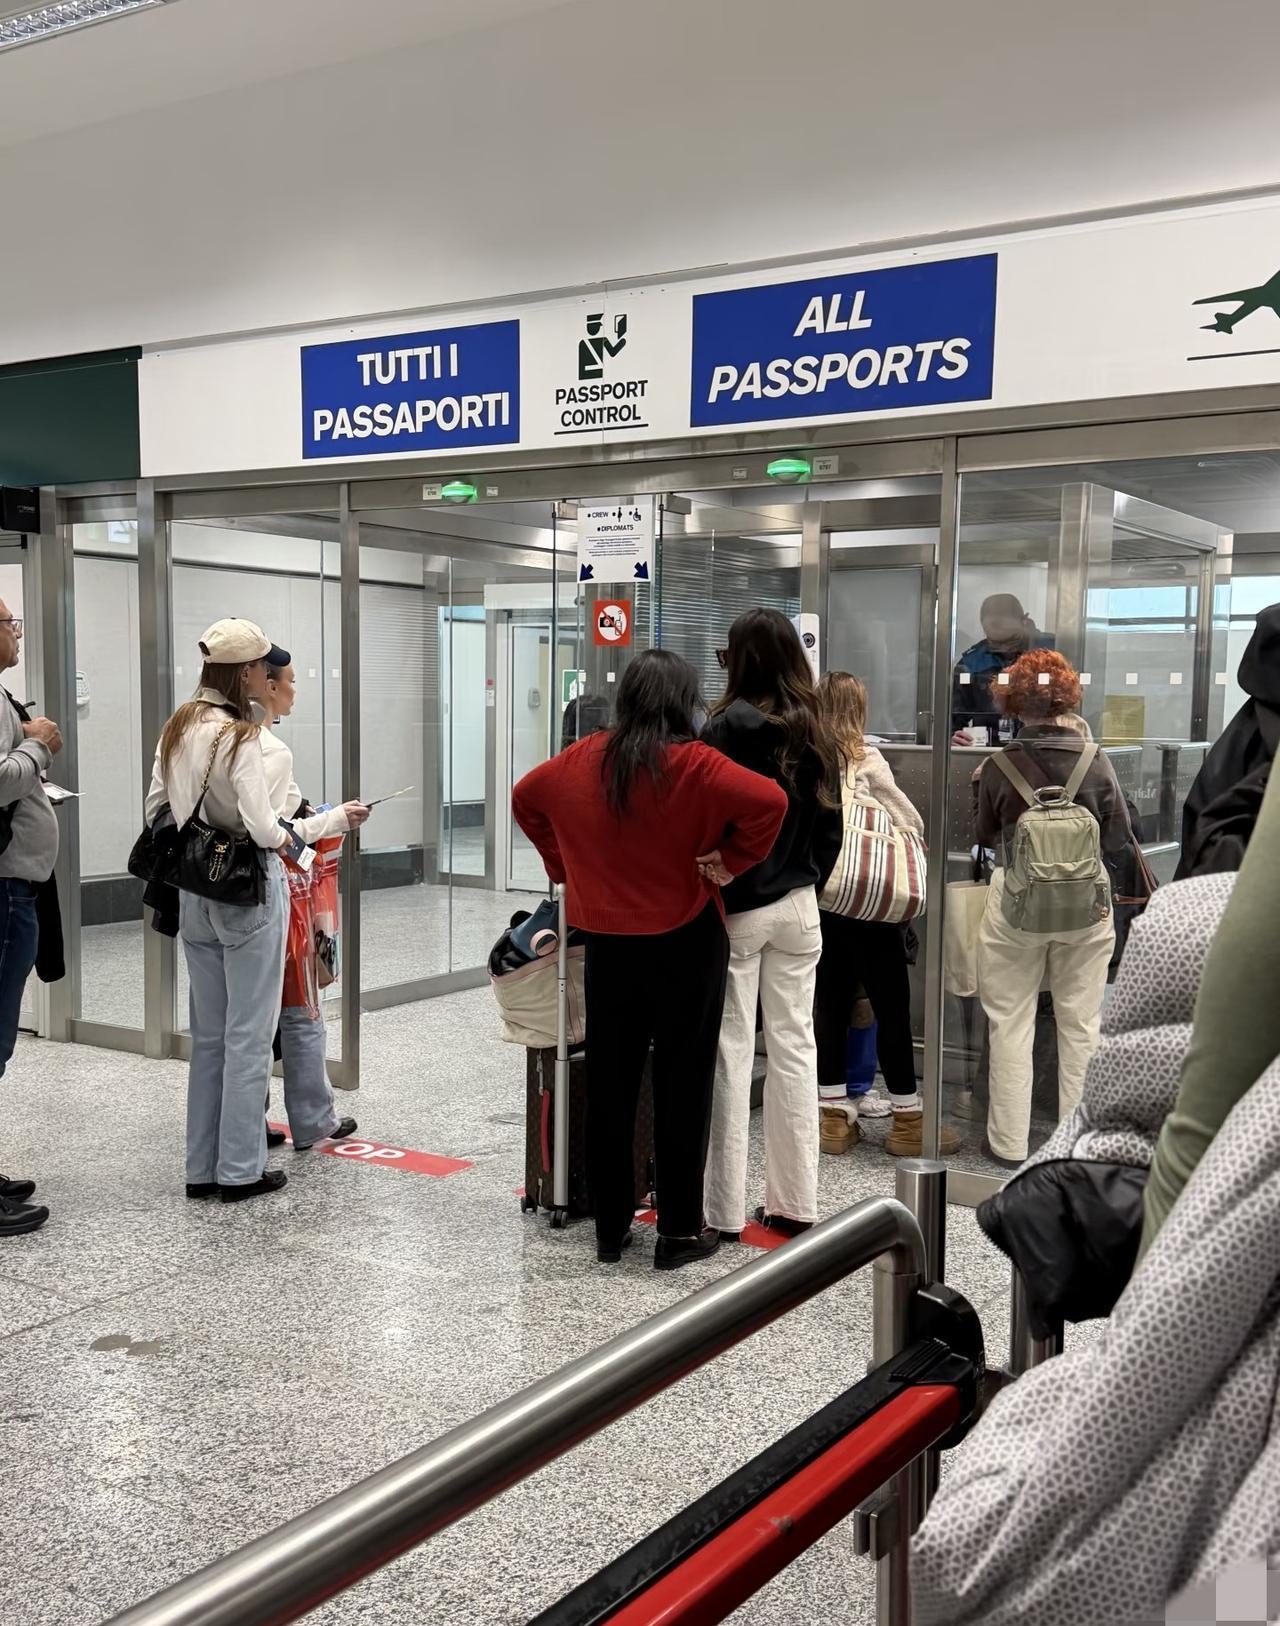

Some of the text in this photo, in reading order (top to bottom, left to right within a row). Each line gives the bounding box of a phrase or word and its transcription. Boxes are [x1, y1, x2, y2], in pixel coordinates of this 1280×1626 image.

[792, 290, 873, 337] ALL
[356, 343, 458, 386] TUTTI I
[707, 337, 972, 404] PASSPORTS
[555, 379, 649, 406] PASSPORT
[313, 391, 510, 442] PASSAPORTI
[560, 403, 642, 427] CONTROL
[601, 524, 634, 532] DIPLOMATS
[333, 1142, 406, 1159] OP
